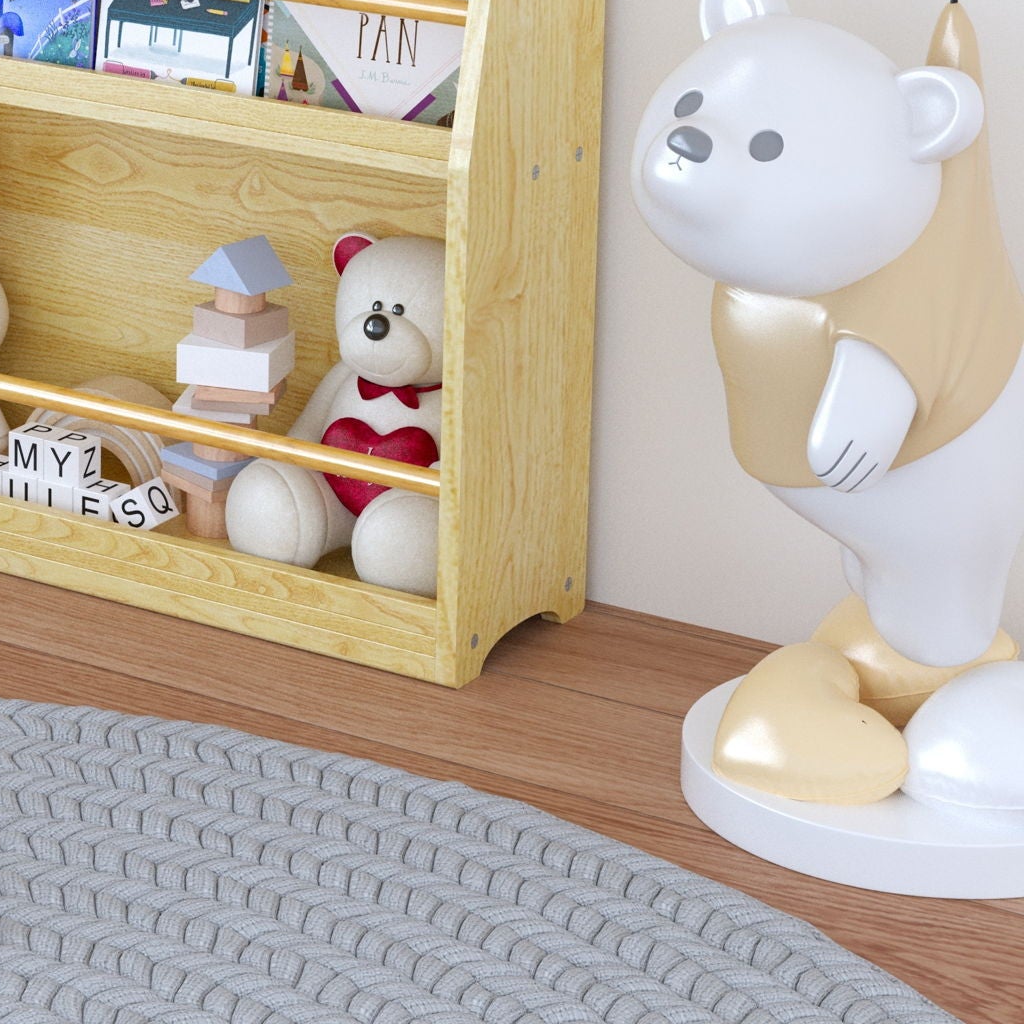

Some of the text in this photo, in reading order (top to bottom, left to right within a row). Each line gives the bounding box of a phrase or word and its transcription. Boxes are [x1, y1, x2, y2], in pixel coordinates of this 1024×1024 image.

[356, 12, 419, 67] PAN
[14, 438, 72, 478] MY
[147, 486, 173, 514] Q
